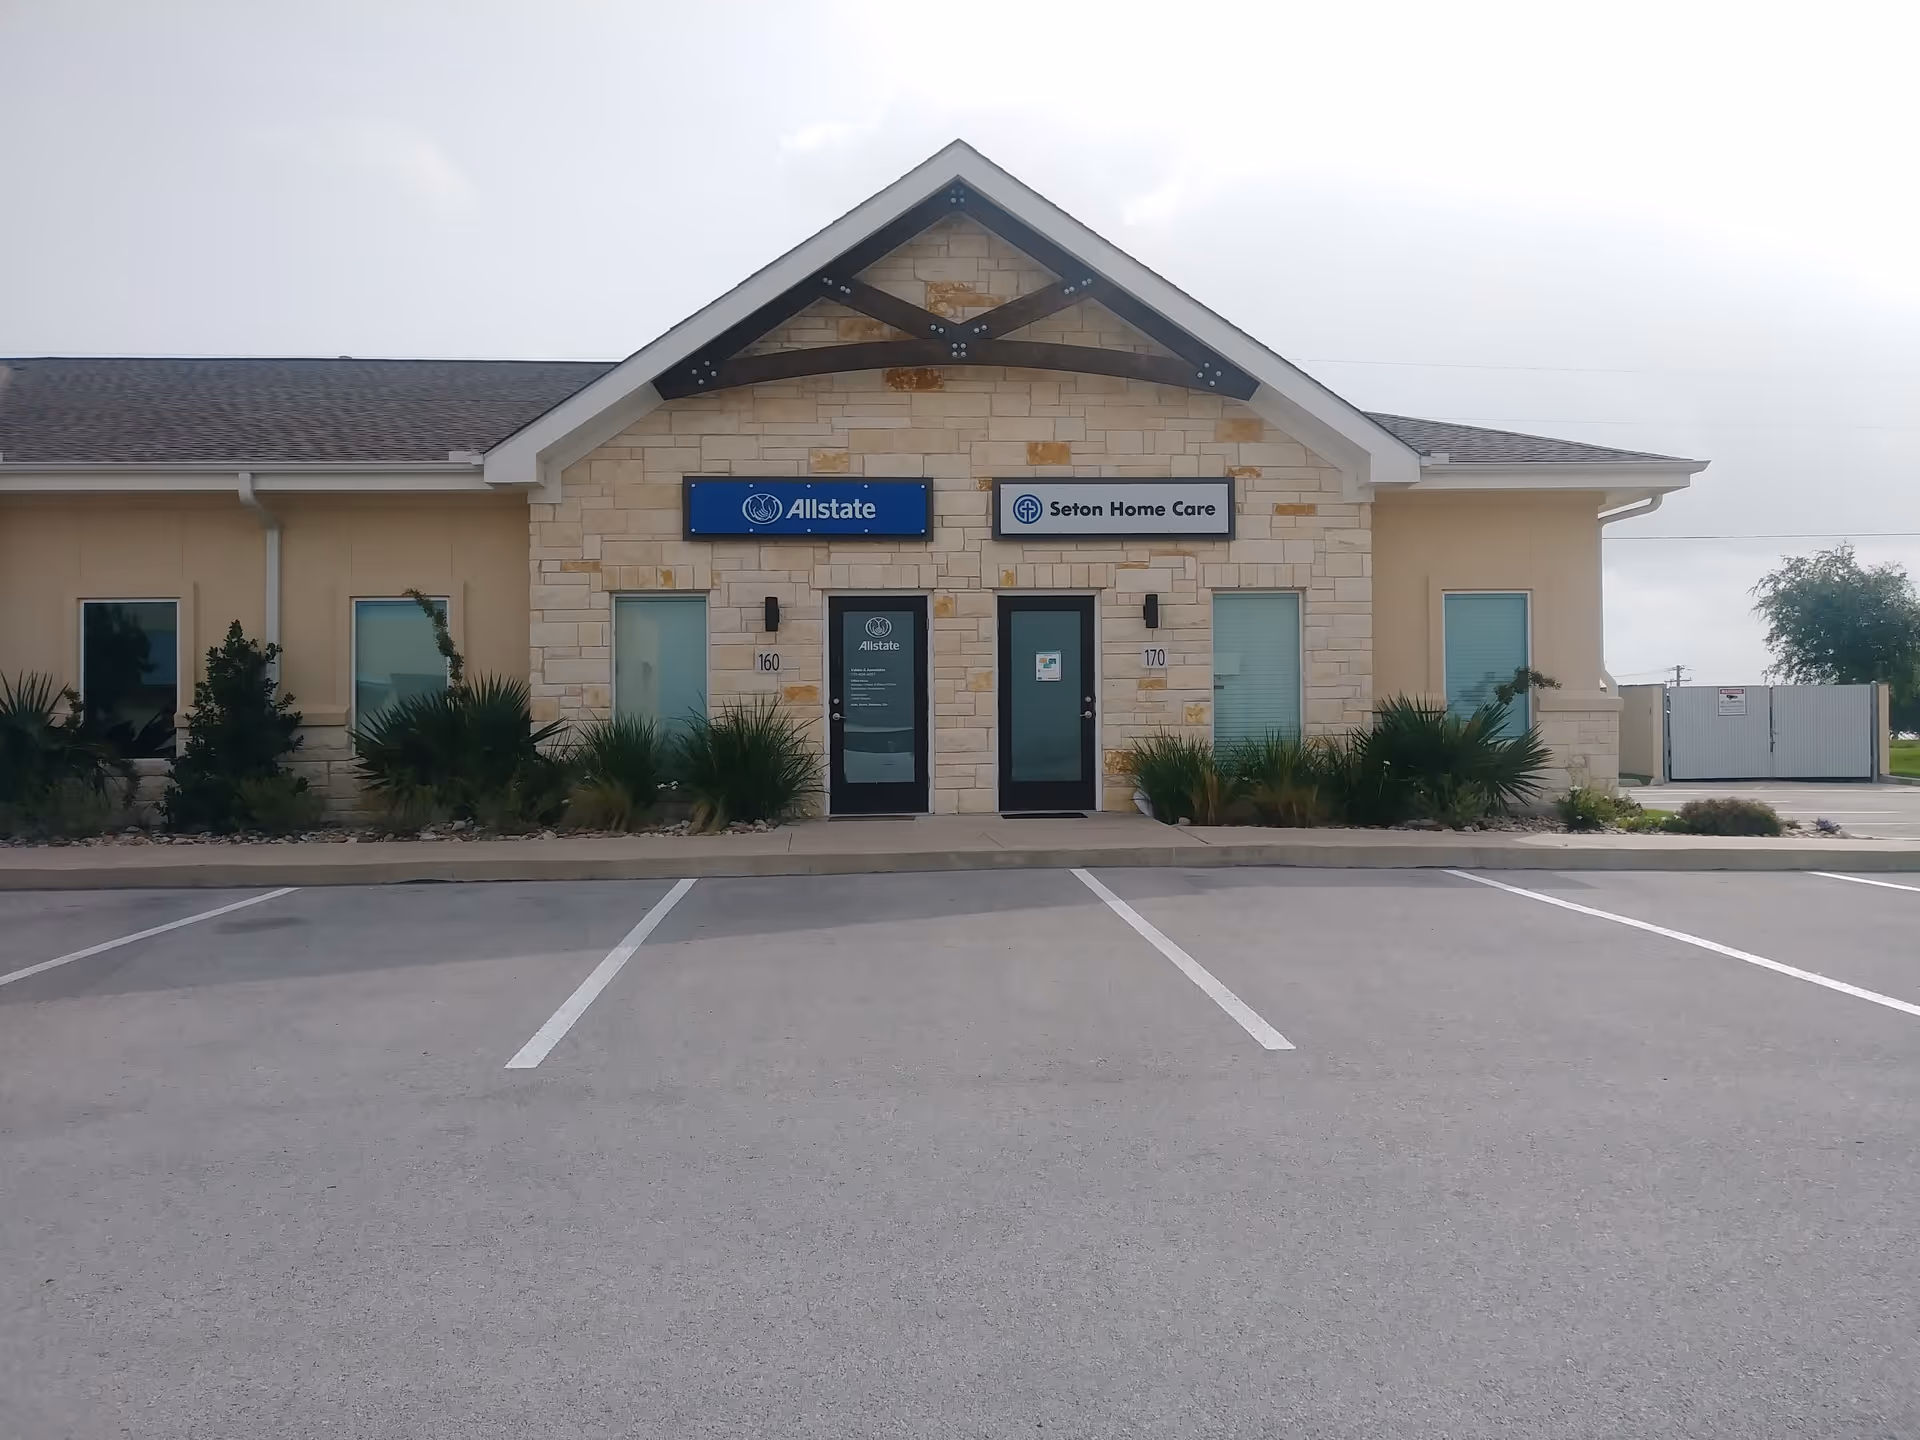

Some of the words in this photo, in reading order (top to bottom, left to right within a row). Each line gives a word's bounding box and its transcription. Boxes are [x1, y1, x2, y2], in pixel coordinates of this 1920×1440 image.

[785, 498, 876, 519] Allstate
[1049, 501, 1103, 517] Seton
[1110, 501, 1166, 517] Home
[1172, 500, 1216, 516] Care
[857, 640, 900, 651] Allstate
[758, 653, 780, 671] 160
[1144, 648, 1165, 666] 170
